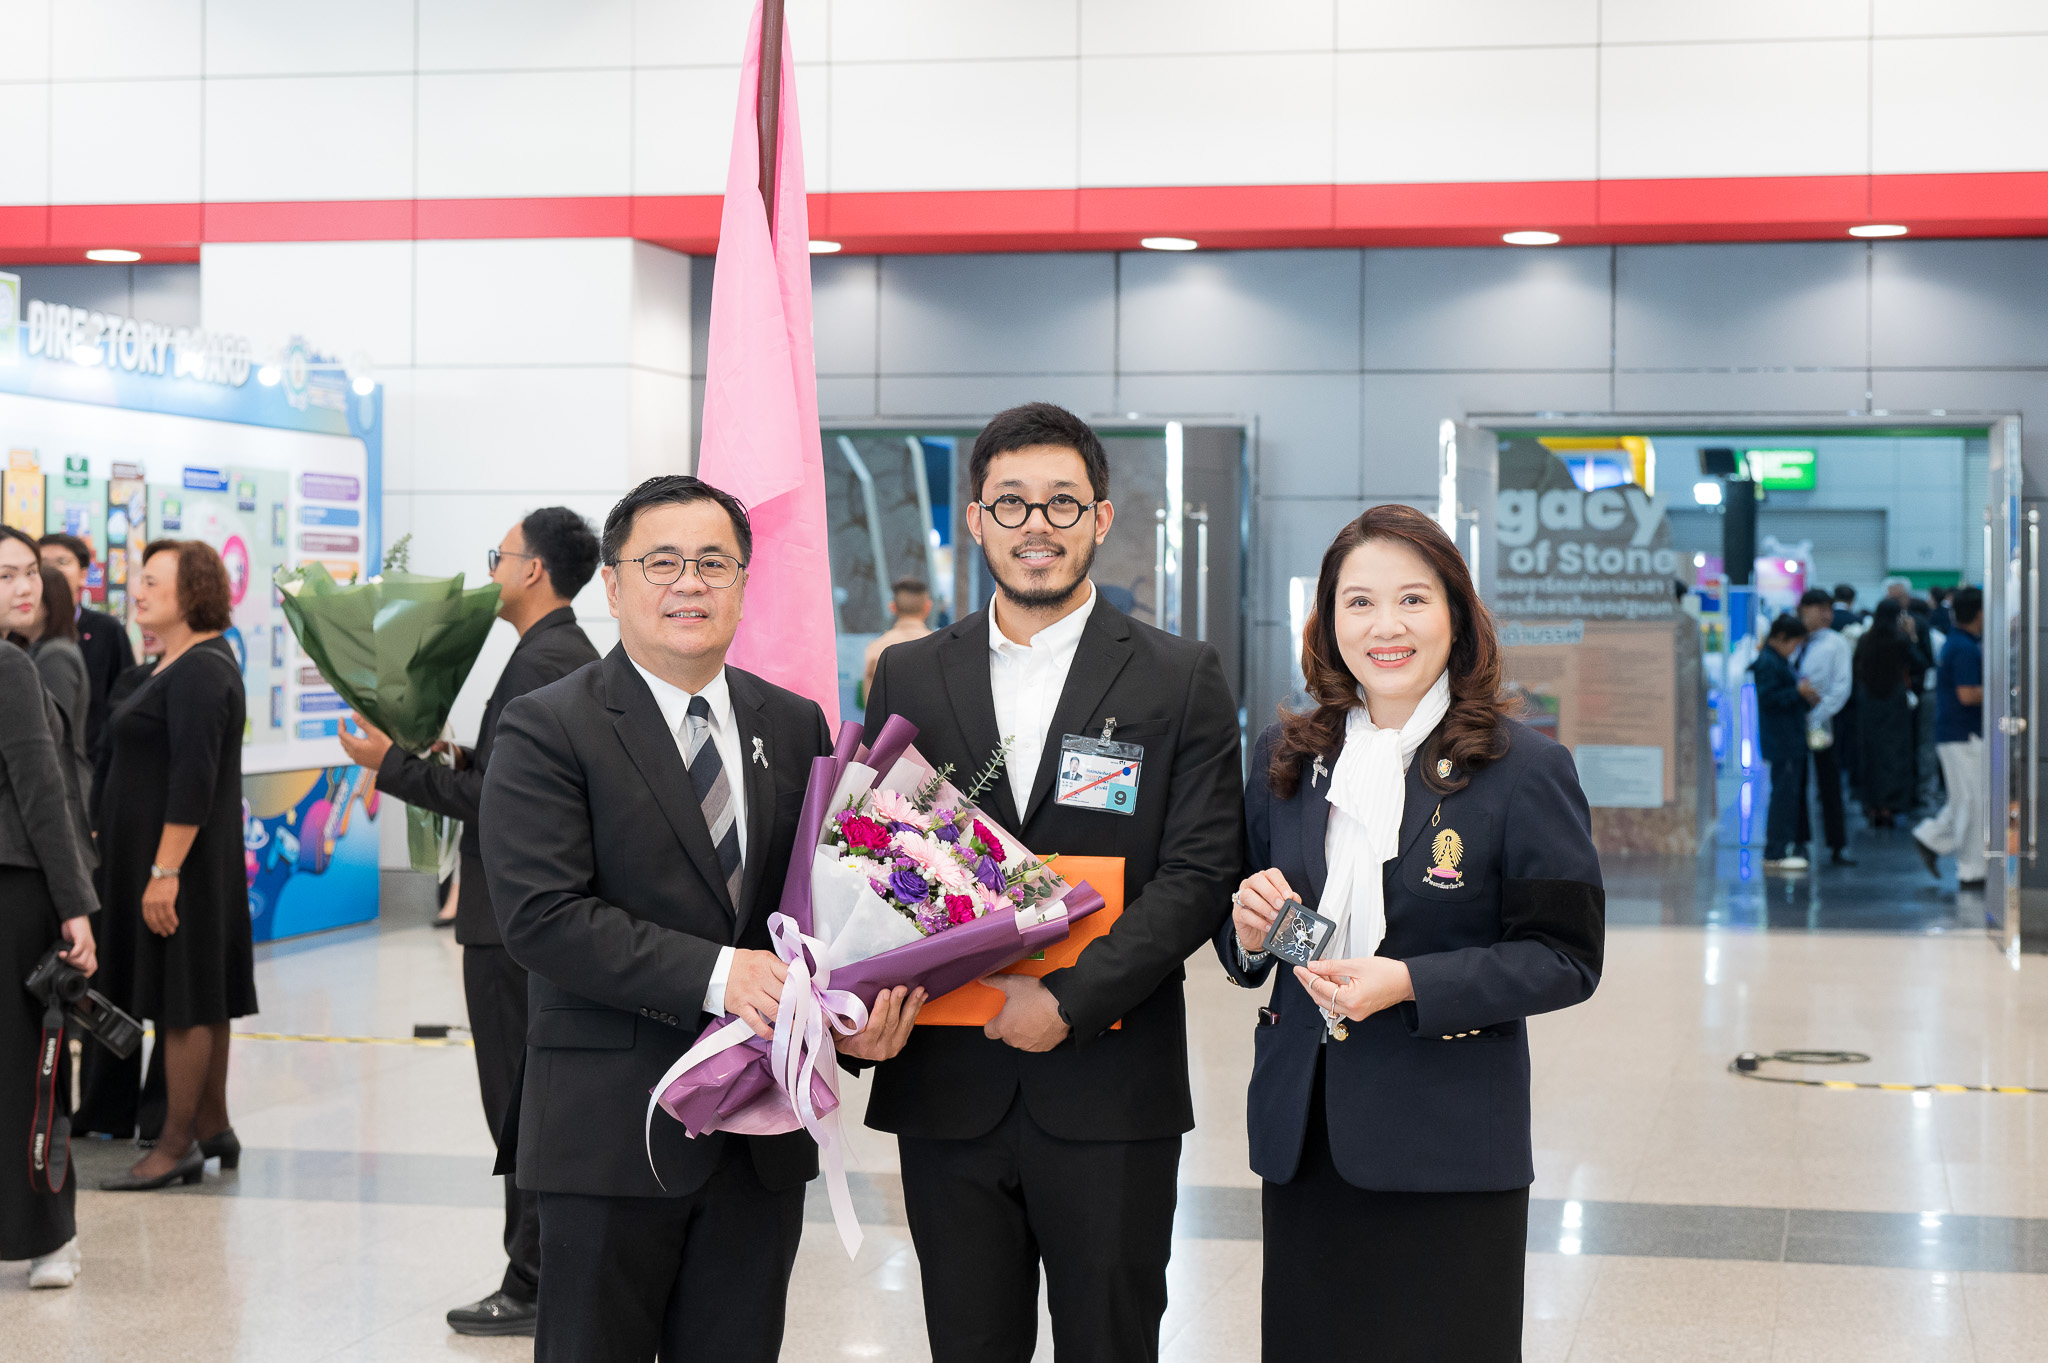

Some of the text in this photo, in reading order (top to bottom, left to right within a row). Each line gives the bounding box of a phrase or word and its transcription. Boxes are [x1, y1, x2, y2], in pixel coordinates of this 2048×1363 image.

[28, 299, 172, 375] DIRECTORY
[1509, 540, 1678, 574] of Stone
[1115, 791, 1126, 805] 9
[43, 1038, 56, 1075] Canon
[35, 1134, 45, 1170] Canon
